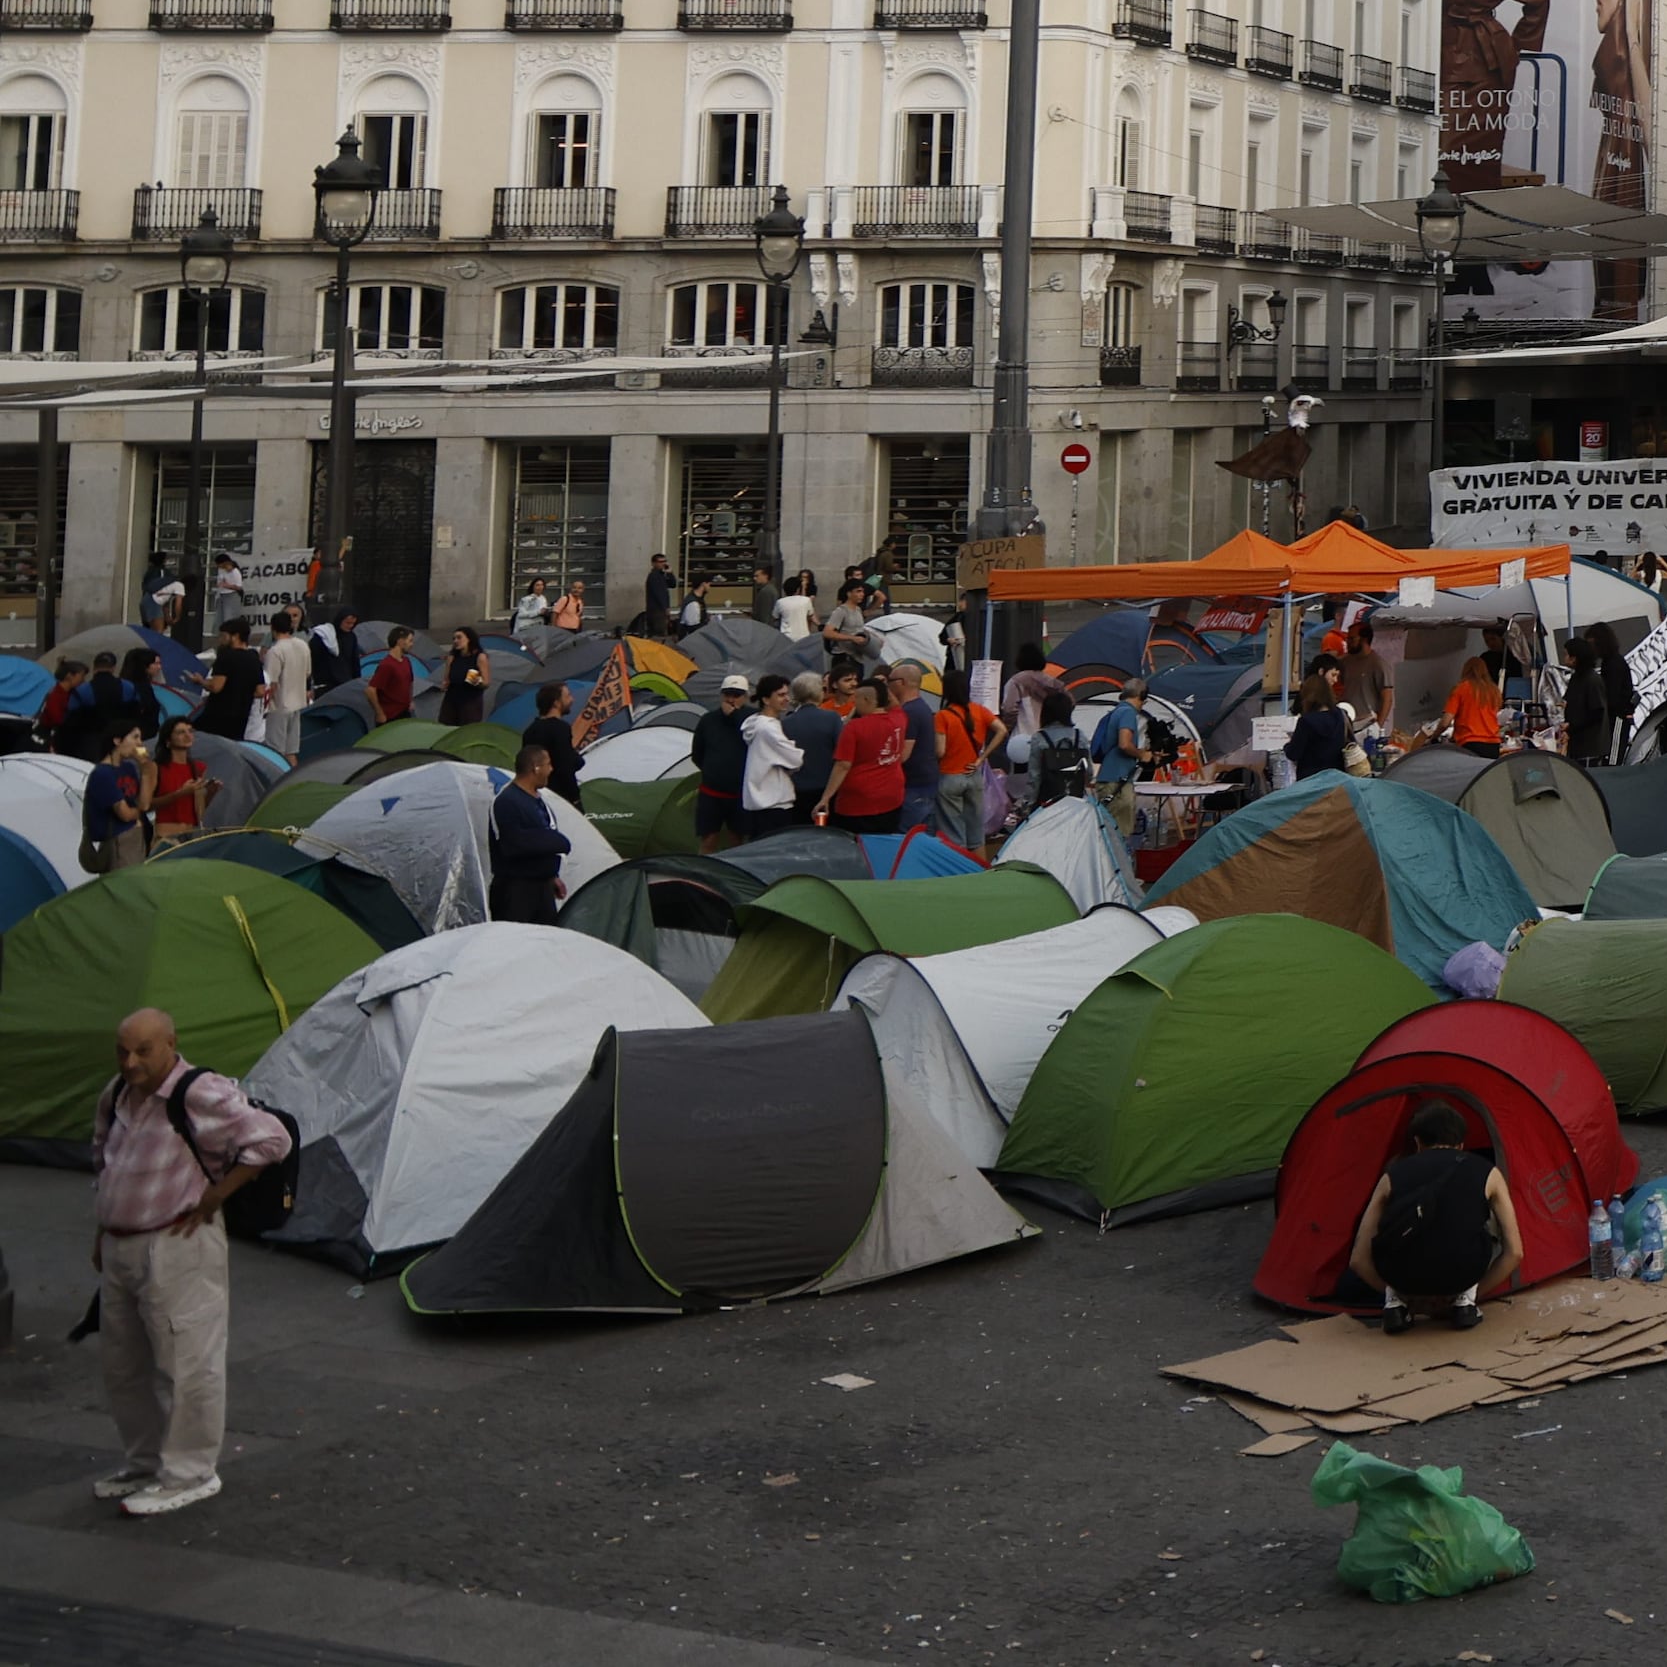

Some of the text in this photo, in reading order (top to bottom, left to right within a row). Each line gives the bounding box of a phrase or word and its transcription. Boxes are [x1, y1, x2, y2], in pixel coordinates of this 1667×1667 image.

[1451, 88, 1555, 108] EL OTOÑO
[1455, 112, 1549, 131] LA MODA
[1452, 469, 1571, 490] VIVIENDA
[1442, 494, 1557, 515] GRATUITA
[1563, 493, 1582, 510] Y
[1588, 494, 1623, 510] DE
[250, 560, 309, 579] ACABÓ
